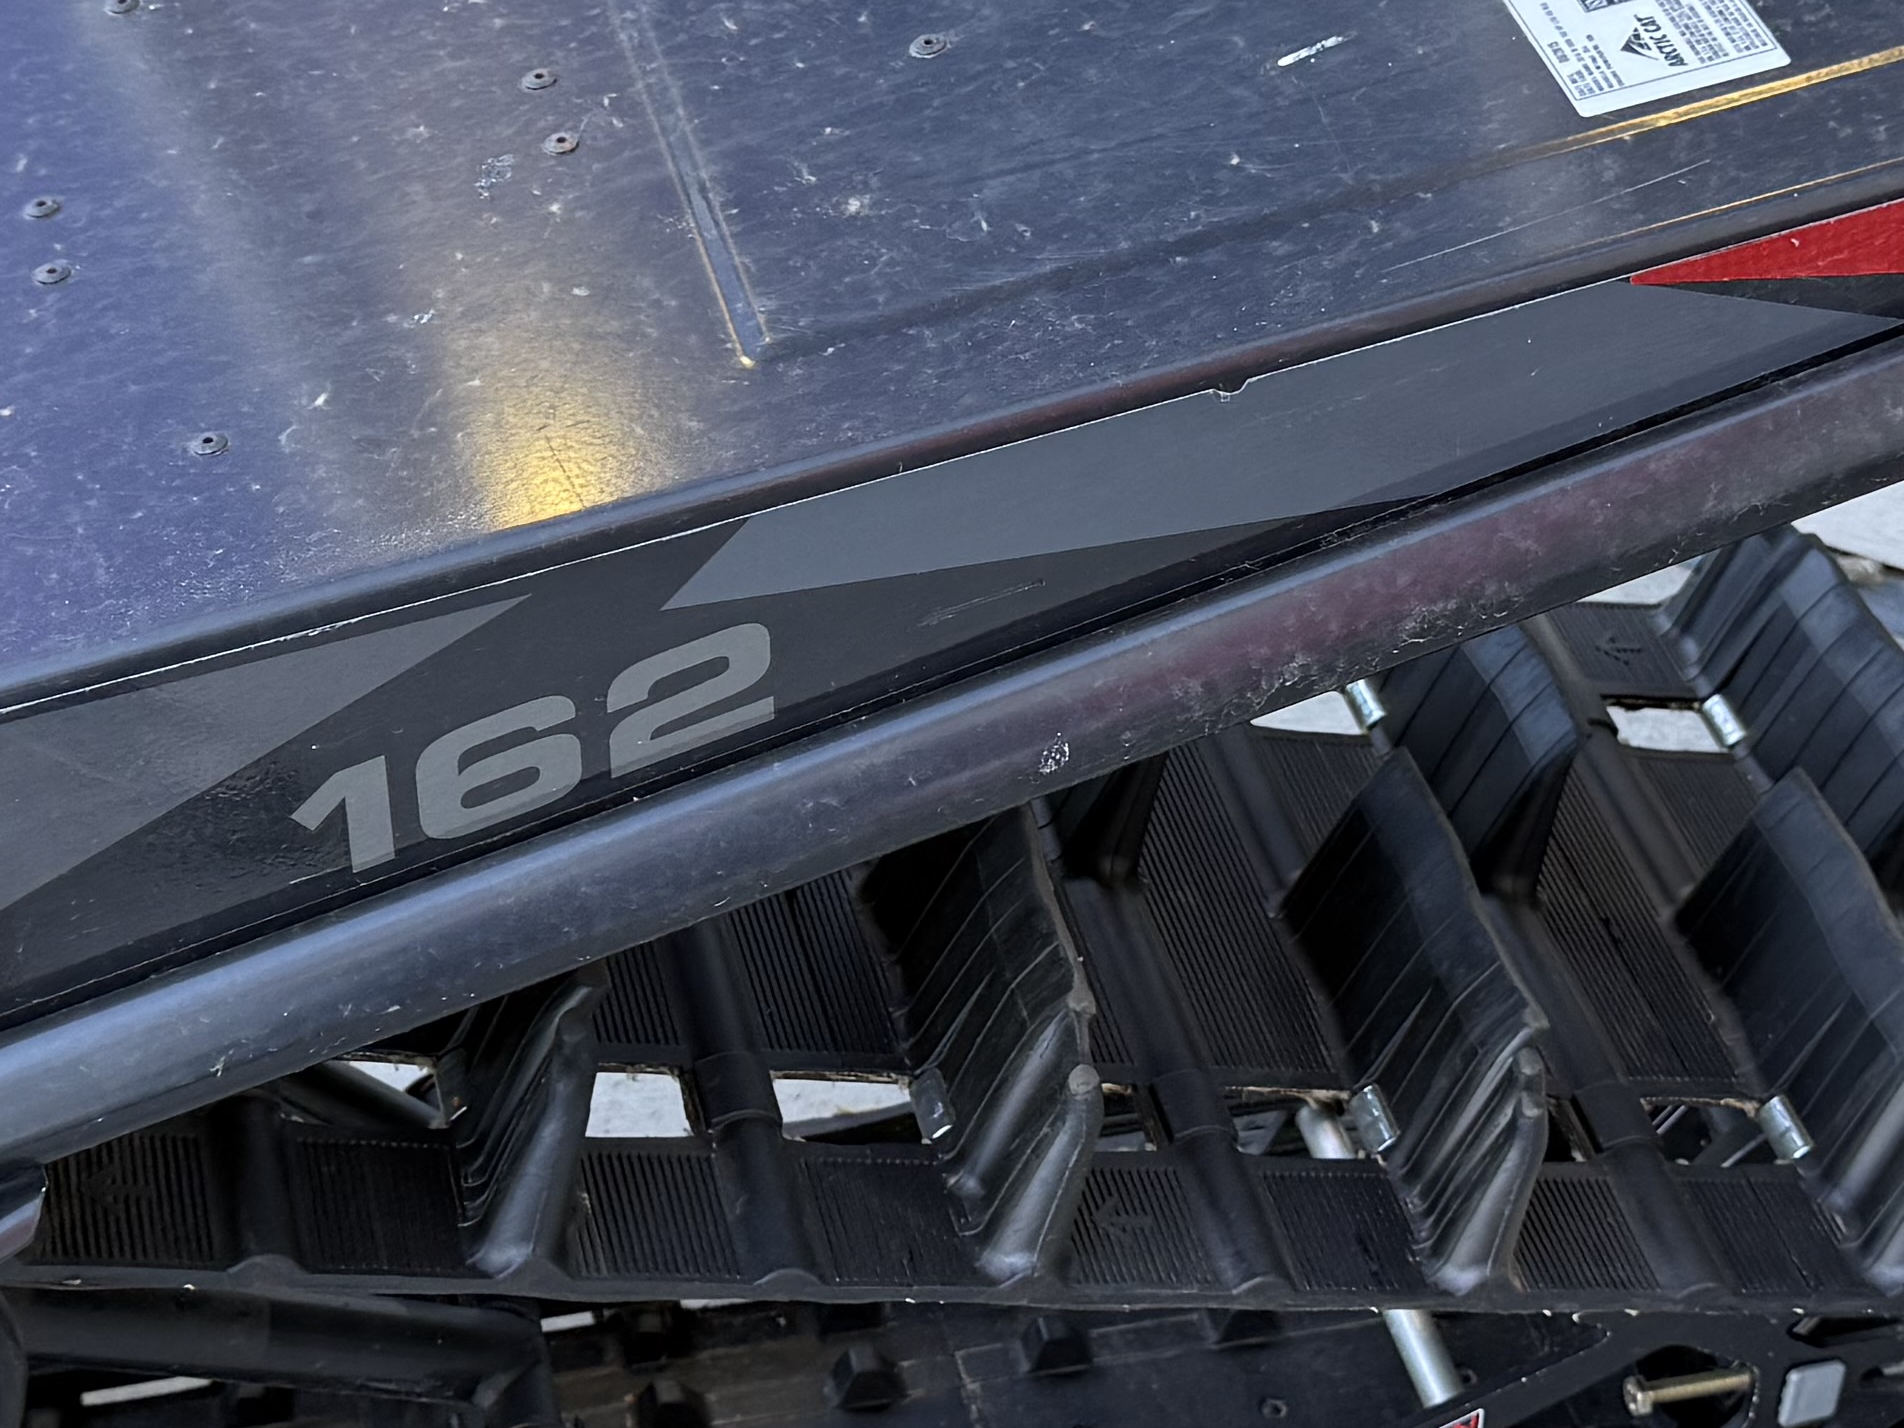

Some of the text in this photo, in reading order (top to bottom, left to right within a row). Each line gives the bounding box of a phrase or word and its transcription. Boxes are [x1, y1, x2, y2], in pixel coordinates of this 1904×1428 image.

[1633, 13, 1689, 68] ARCTIC CAT
[290, 622, 775, 873] 162
